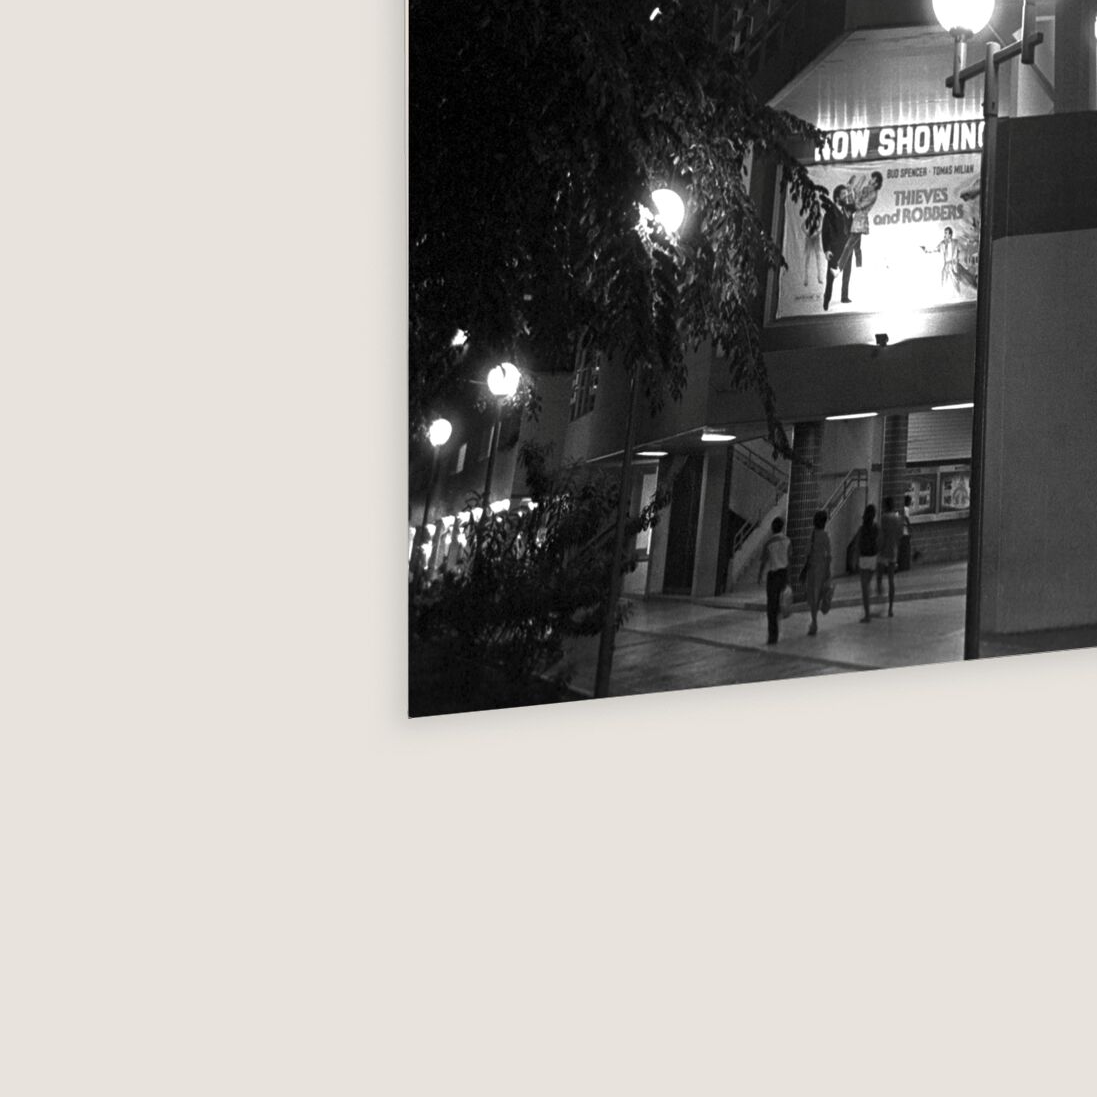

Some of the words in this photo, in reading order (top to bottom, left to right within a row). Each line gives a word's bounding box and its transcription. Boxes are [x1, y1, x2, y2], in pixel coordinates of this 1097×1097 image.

[886, 168, 899, 179] BUD
[900, 167, 927, 178] SPENCER
[933, 165, 953, 175] TOMAS
[893, 187, 948, 206] THIEVES
[873, 208, 900, 225] and
[902, 204, 963, 223] ROBBERS
